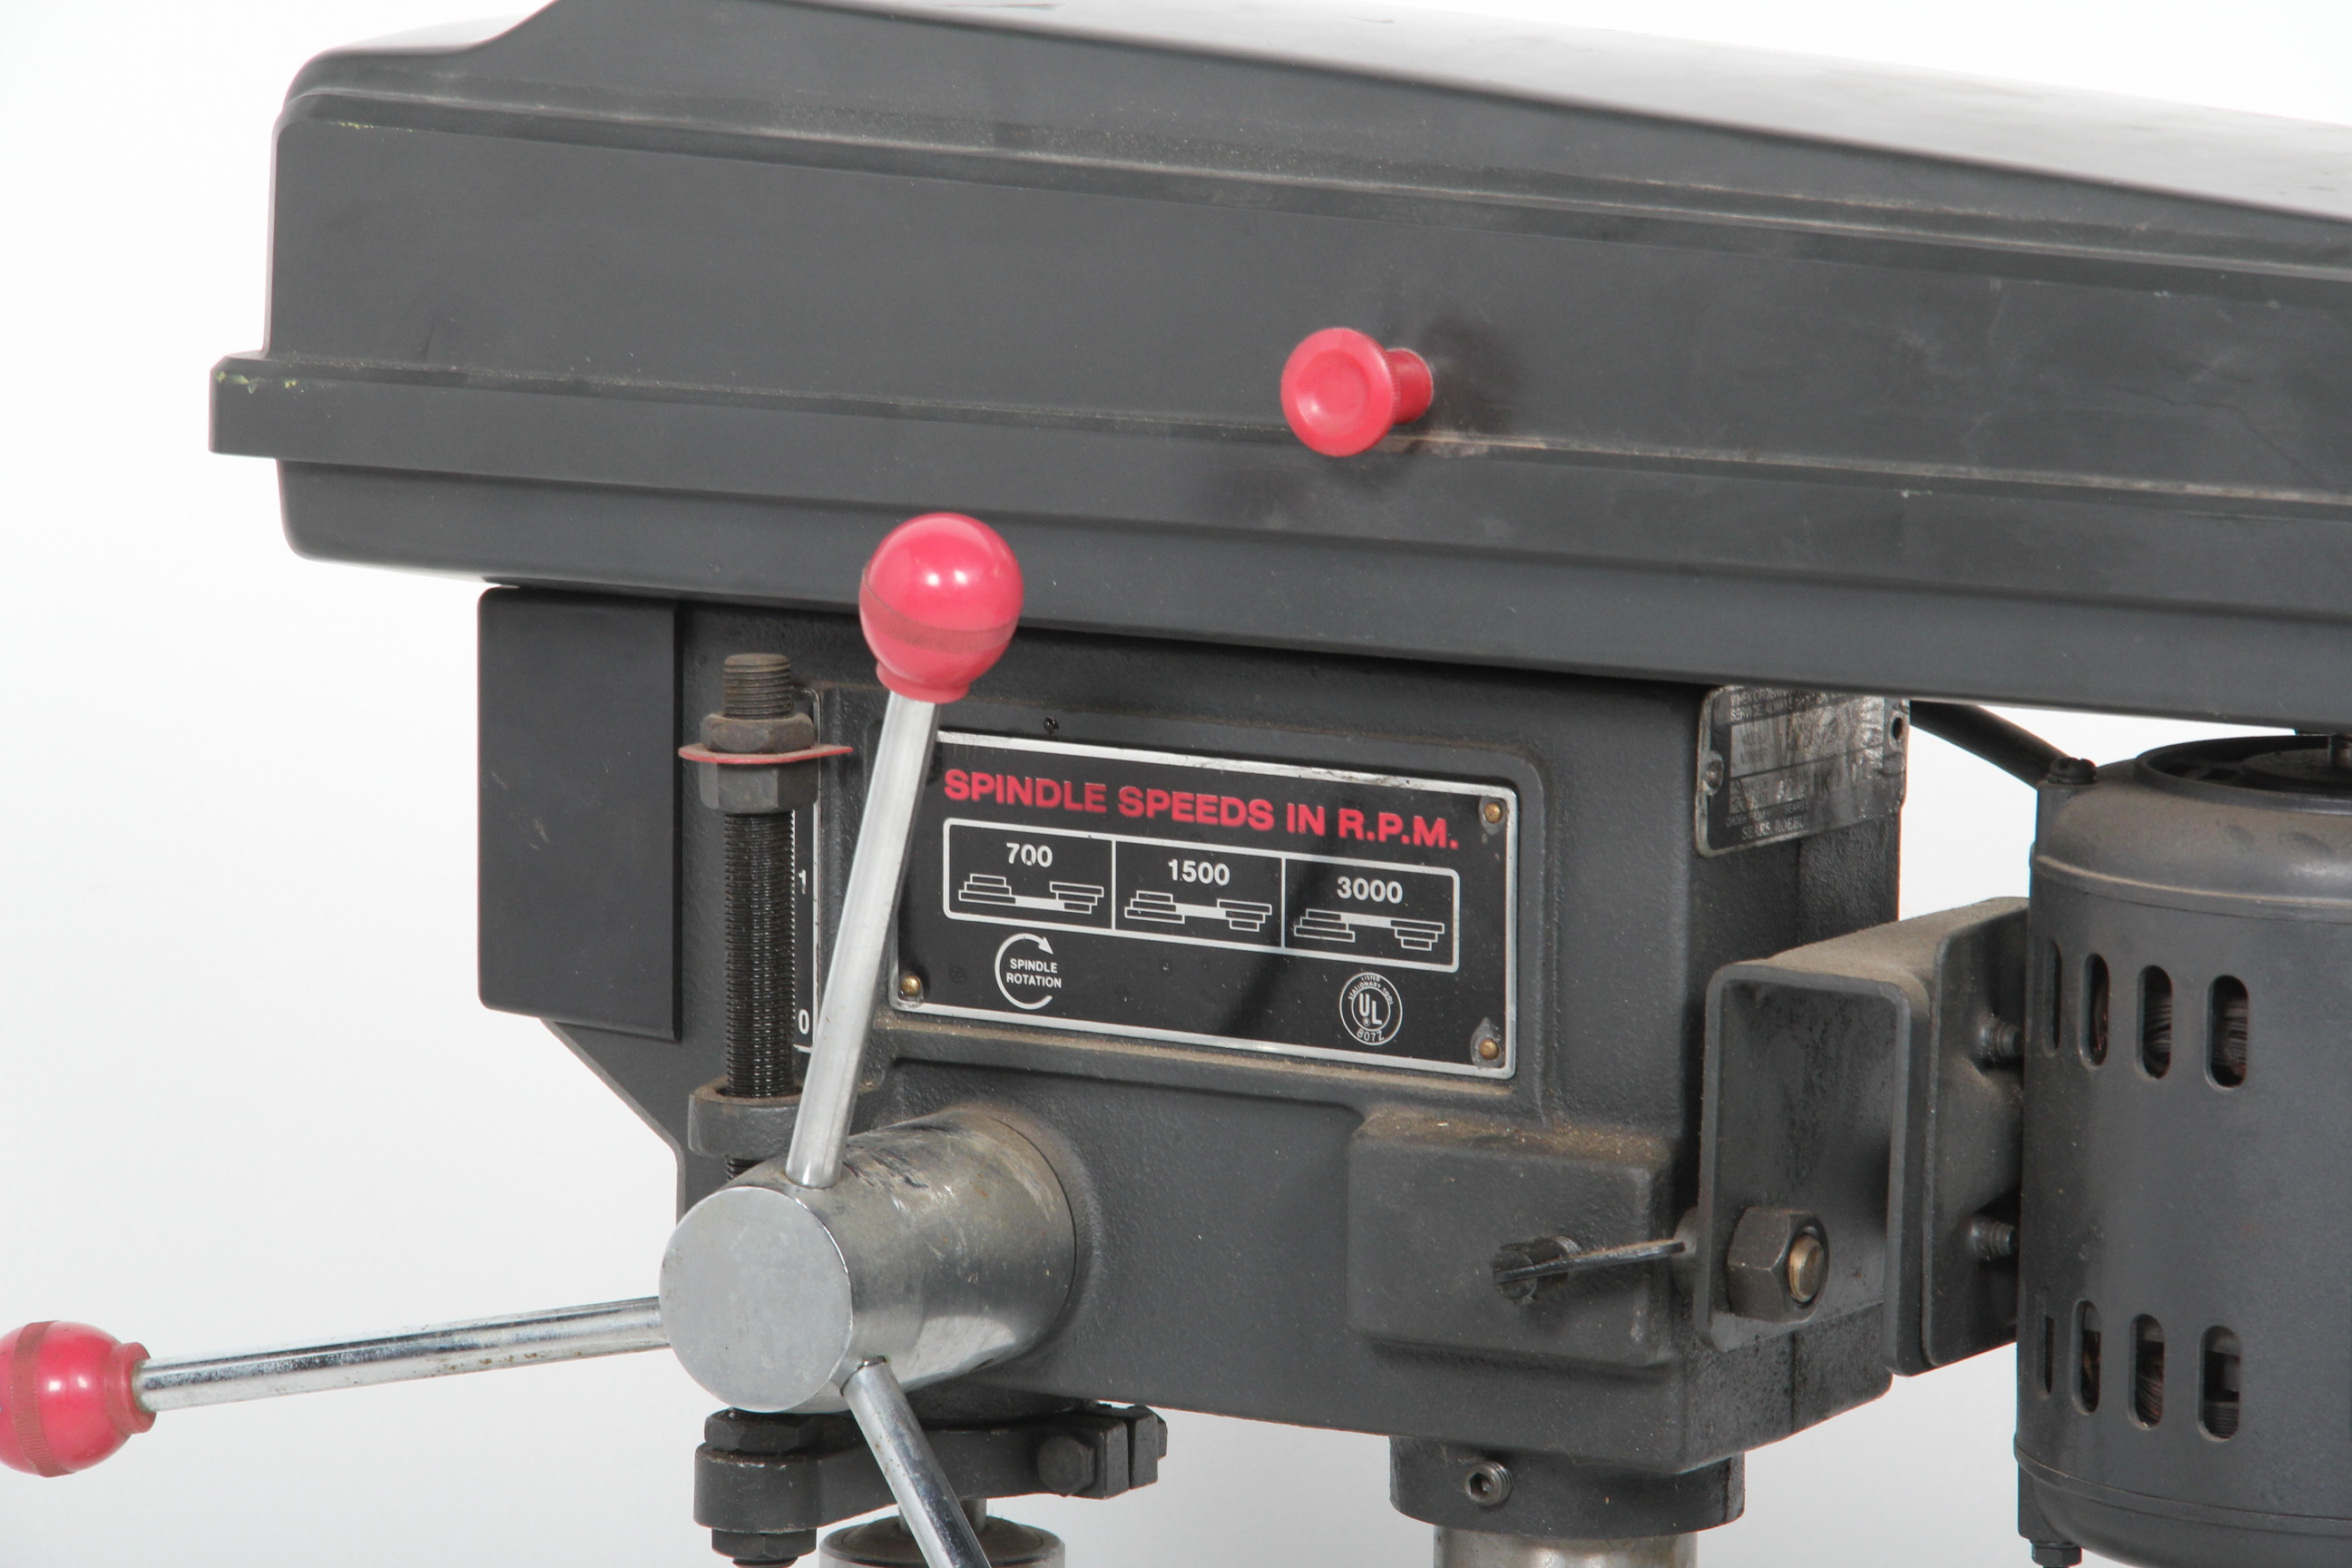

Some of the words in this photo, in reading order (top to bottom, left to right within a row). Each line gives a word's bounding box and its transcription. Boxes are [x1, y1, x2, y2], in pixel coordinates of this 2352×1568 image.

[944, 769, 1107, 813] SPINDLE
[1118, 786, 1275, 831] SPEEDS
[1287, 803, 1326, 837] IN
[1338, 808, 1459, 850] R.P.M.
[1005, 842, 1053, 867] 700
[798, 868, 807, 895] 1
[1168, 858, 1230, 887] 1500
[1337, 876, 1404, 904] 3000
[1010, 958, 1058, 974] SPINDLE
[1006, 972, 1063, 989] ROTATION
[798, 1008, 810, 1035] 0
[1358, 993, 1383, 1025] UL
